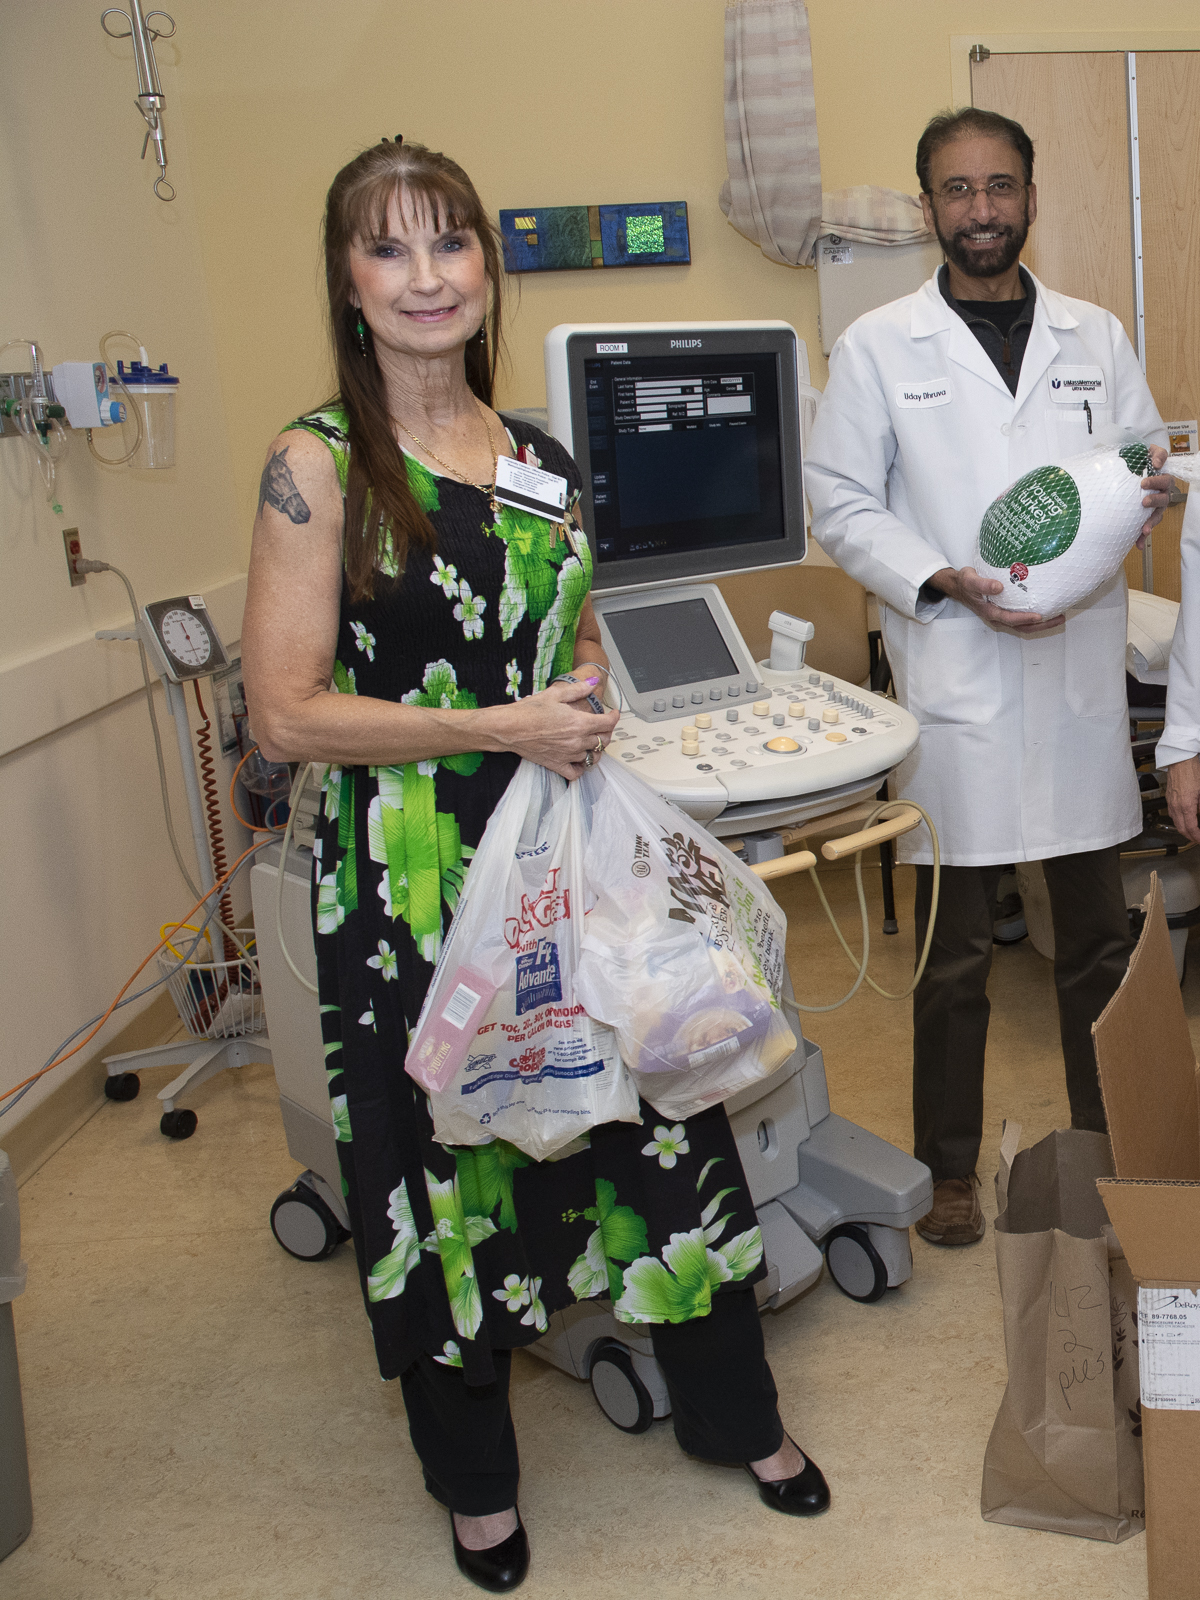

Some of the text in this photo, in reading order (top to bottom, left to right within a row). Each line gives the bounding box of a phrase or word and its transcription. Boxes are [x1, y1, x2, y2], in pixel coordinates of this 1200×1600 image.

[599, 344, 619, 352] ROOM
[670, 339, 702, 349] PHILIPS
[904, 389, 946, 402] Uday Dhruva
[1018, 490, 1051, 524] turkey
[1027, 481, 1063, 517] young
[634, 834, 643, 860] THINK
[518, 964, 557, 992] Advante
[477, 1022, 498, 1036] GET
[507, 1033, 526, 1043] PER
[427, 1041, 452, 1076] STUFFING
[1057, 1328, 1094, 1354] 2
[1058, 1351, 1105, 1412] pies
[1130, 1509, 1145, 1519] Re
